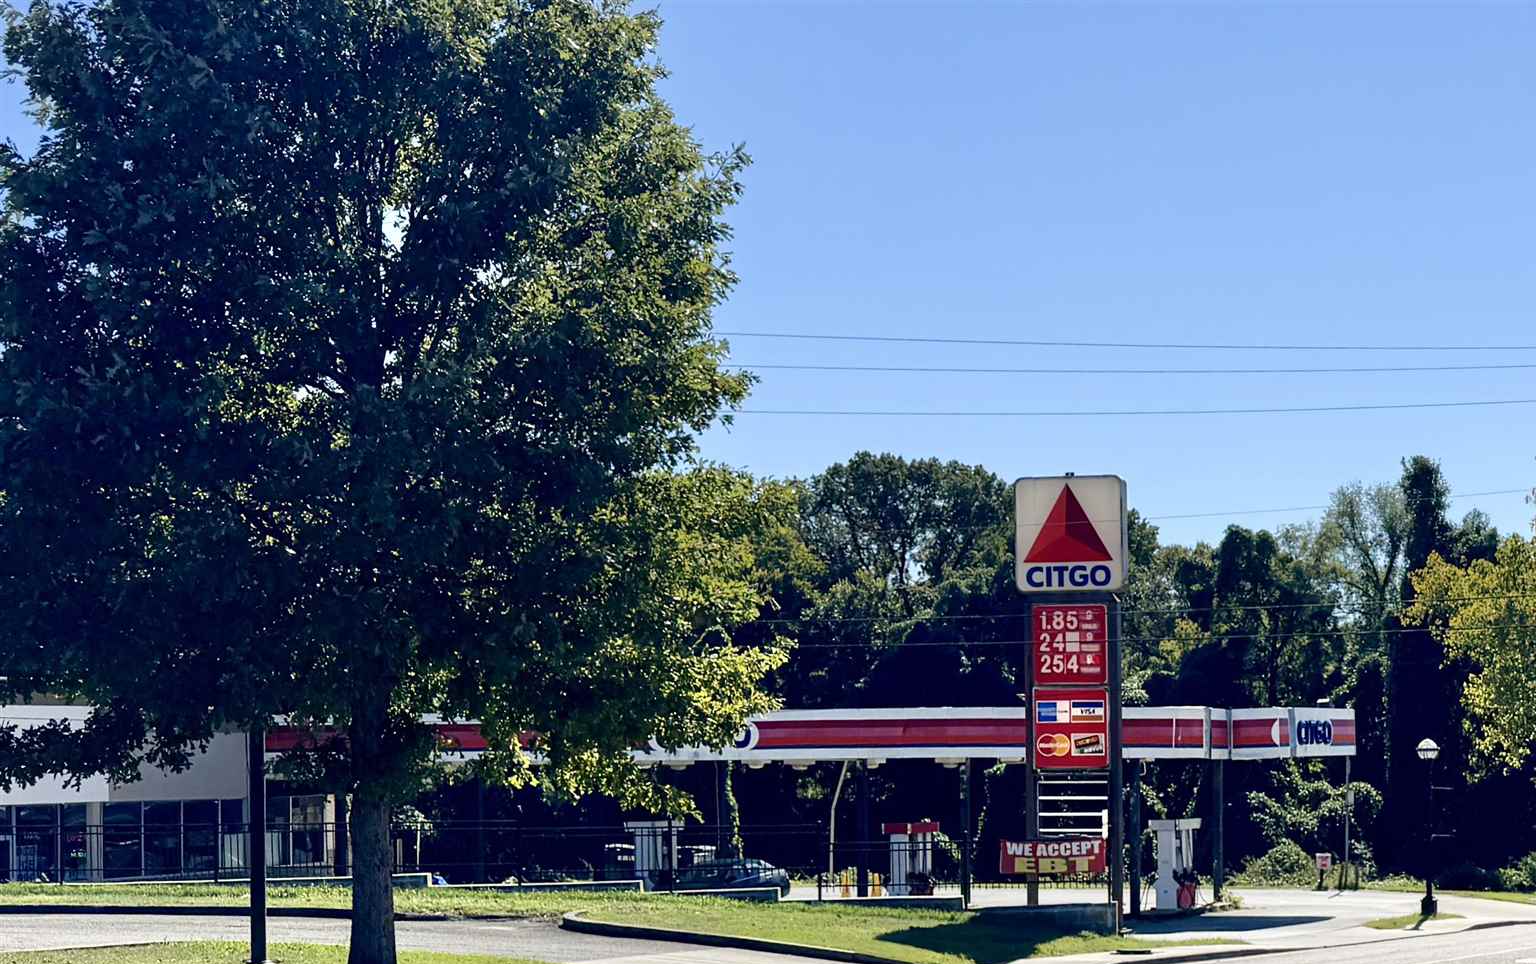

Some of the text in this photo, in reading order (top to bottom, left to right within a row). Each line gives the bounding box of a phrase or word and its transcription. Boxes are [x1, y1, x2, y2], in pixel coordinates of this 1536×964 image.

[1026, 565, 1111, 587] CITGO
[1006, 840, 1102, 857] WE ACCEPT
[1014, 856, 1096, 873] EBT
